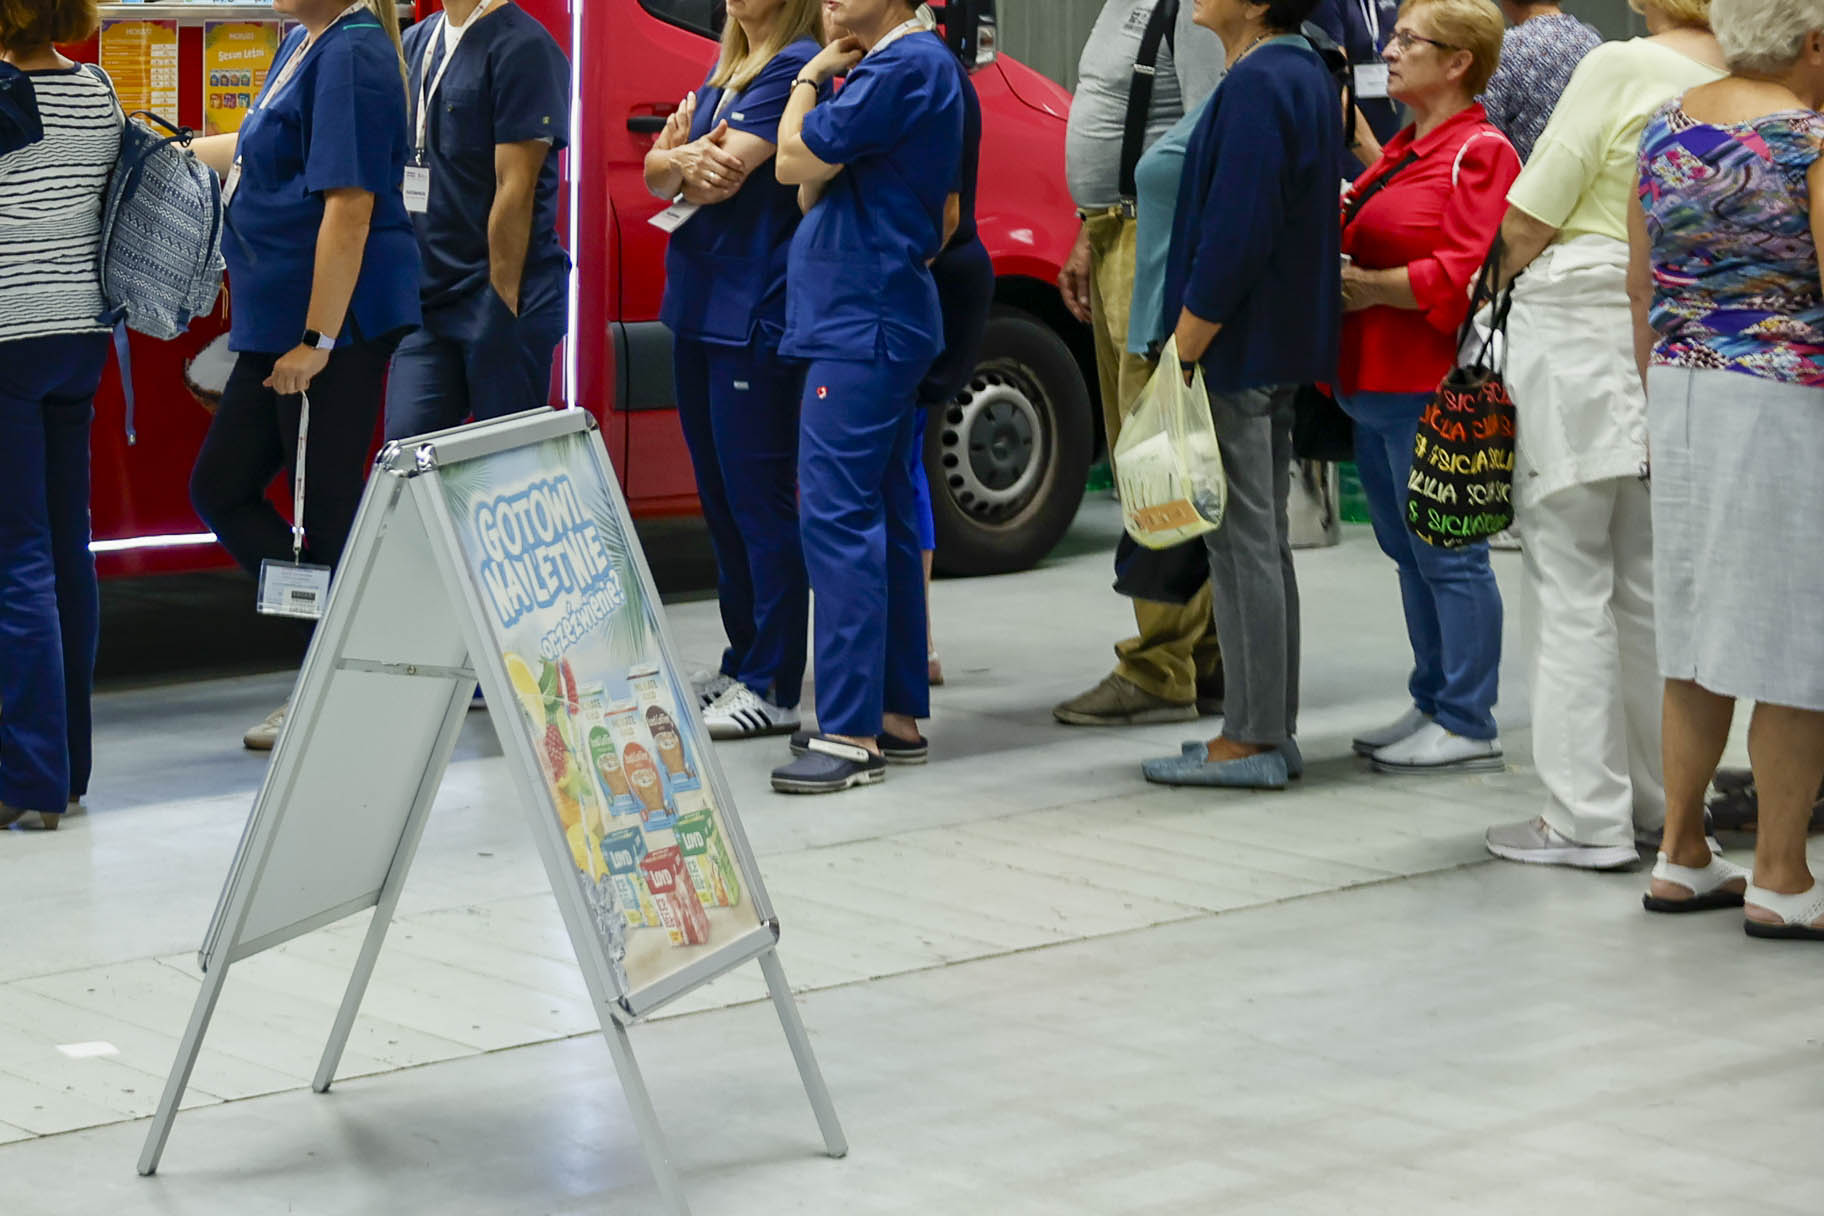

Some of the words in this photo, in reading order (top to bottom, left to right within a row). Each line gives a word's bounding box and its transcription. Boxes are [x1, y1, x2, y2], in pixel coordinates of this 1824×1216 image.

[478, 480, 585, 562] GOTOWI
[484, 560, 532, 622] NA
[523, 525, 609, 603] LETNIE
